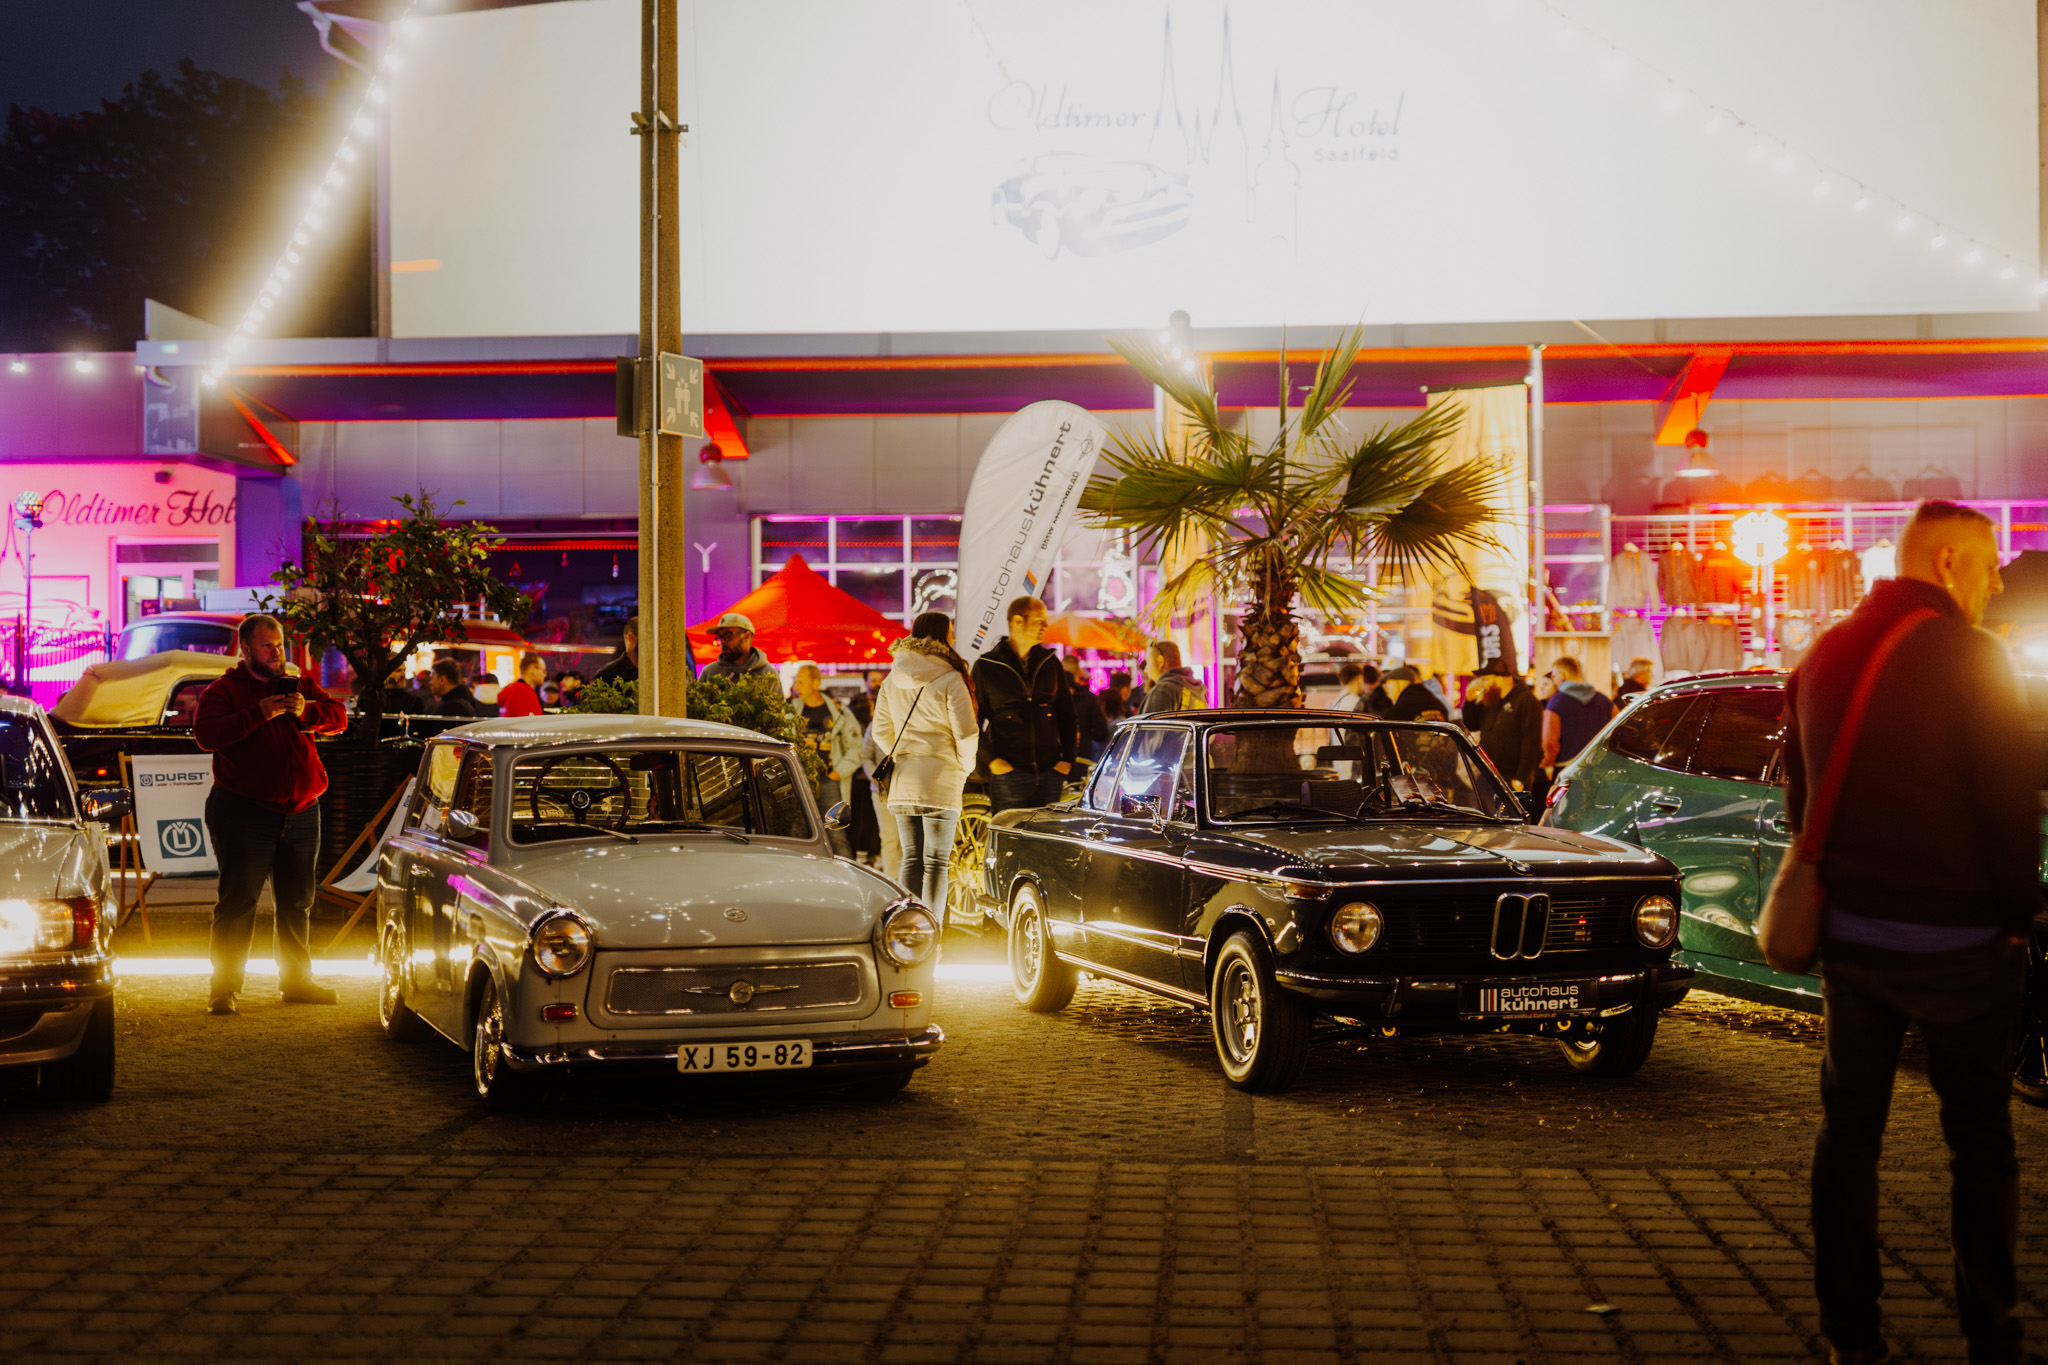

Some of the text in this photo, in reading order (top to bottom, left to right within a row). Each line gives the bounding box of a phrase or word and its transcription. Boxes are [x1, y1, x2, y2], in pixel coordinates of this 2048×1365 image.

[986, 80, 1407, 139] Oldtimer Hotel
[1314, 147, 1400, 162] Saalfeld
[42, 489, 236, 526] Oldtimer Hot
[983, 421, 1071, 625] autohaus kühnert
[1041, 526, 1054, 550] BMW
[1500, 985, 1579, 998] autohaus
[1500, 997, 1579, 1012] kühnert
[684, 1043, 803, 1070] XJ 59-82
